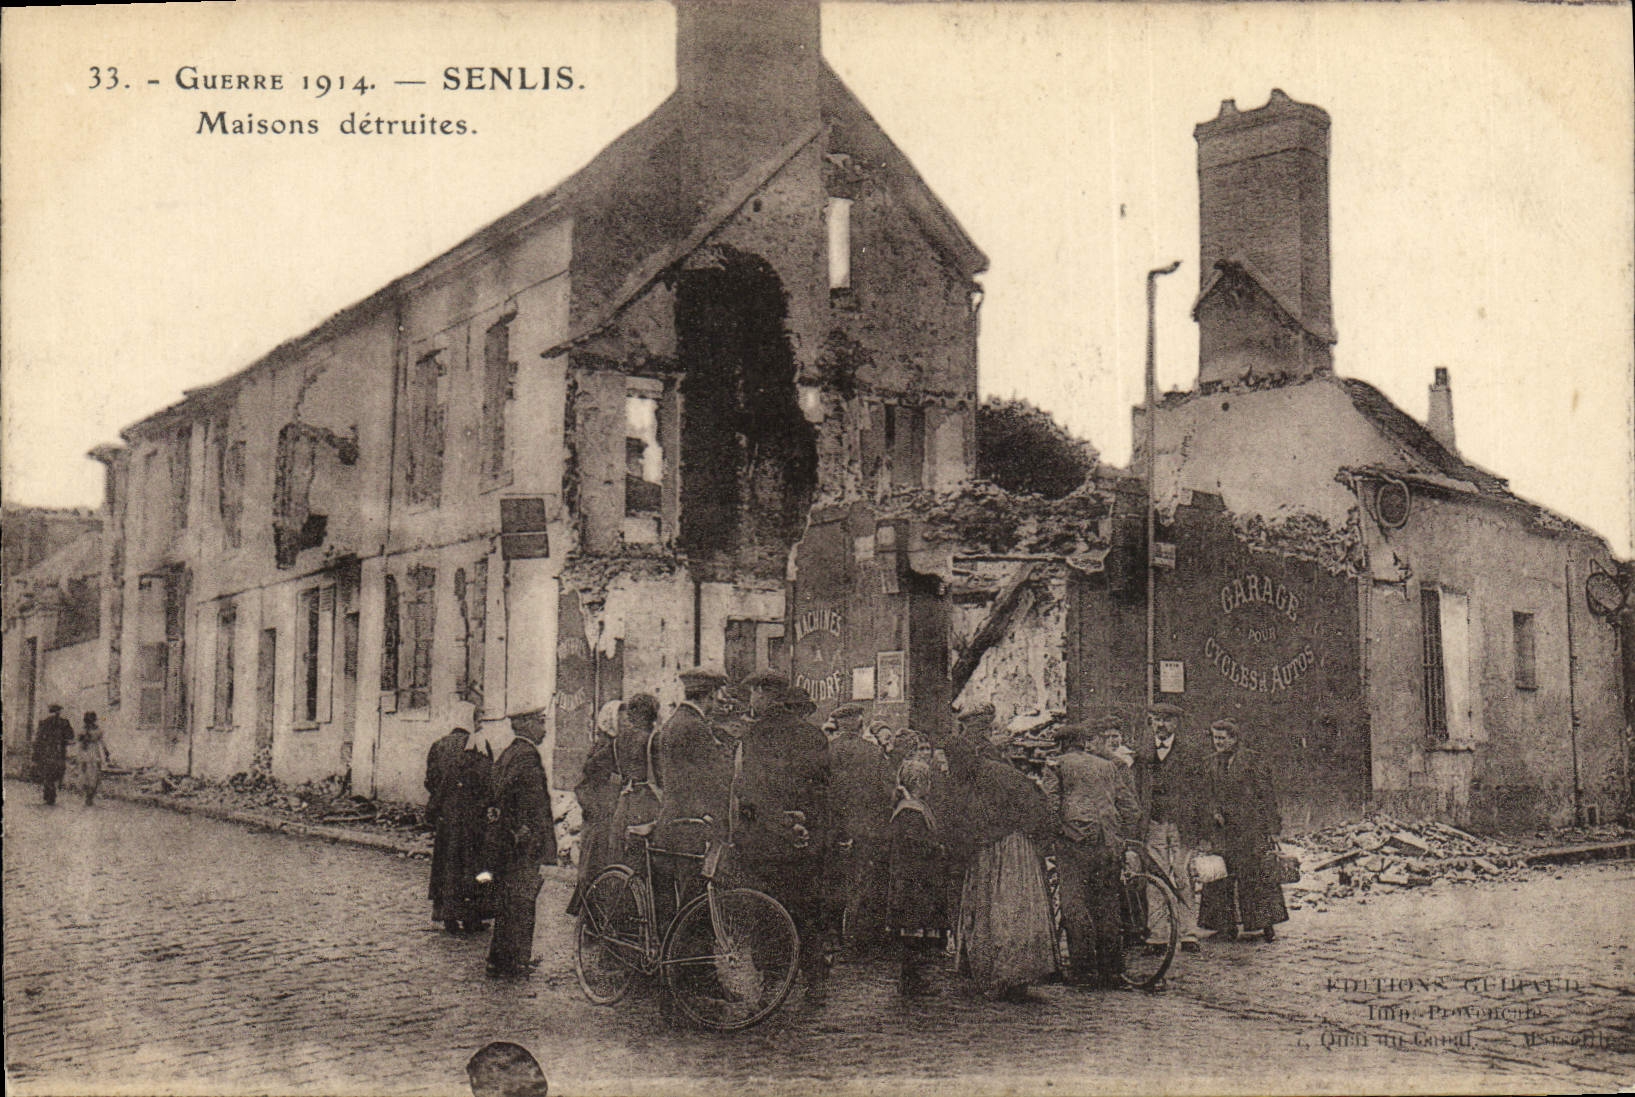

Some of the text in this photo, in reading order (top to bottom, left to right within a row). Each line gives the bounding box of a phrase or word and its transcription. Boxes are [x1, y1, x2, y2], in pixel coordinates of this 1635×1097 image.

[1221, 575, 1299, 621] GARAGE
[1248, 627, 1276, 643] POUR
[1204, 637, 1258, 691] CYCLES
[1271, 645, 1315, 693] AUTOS
